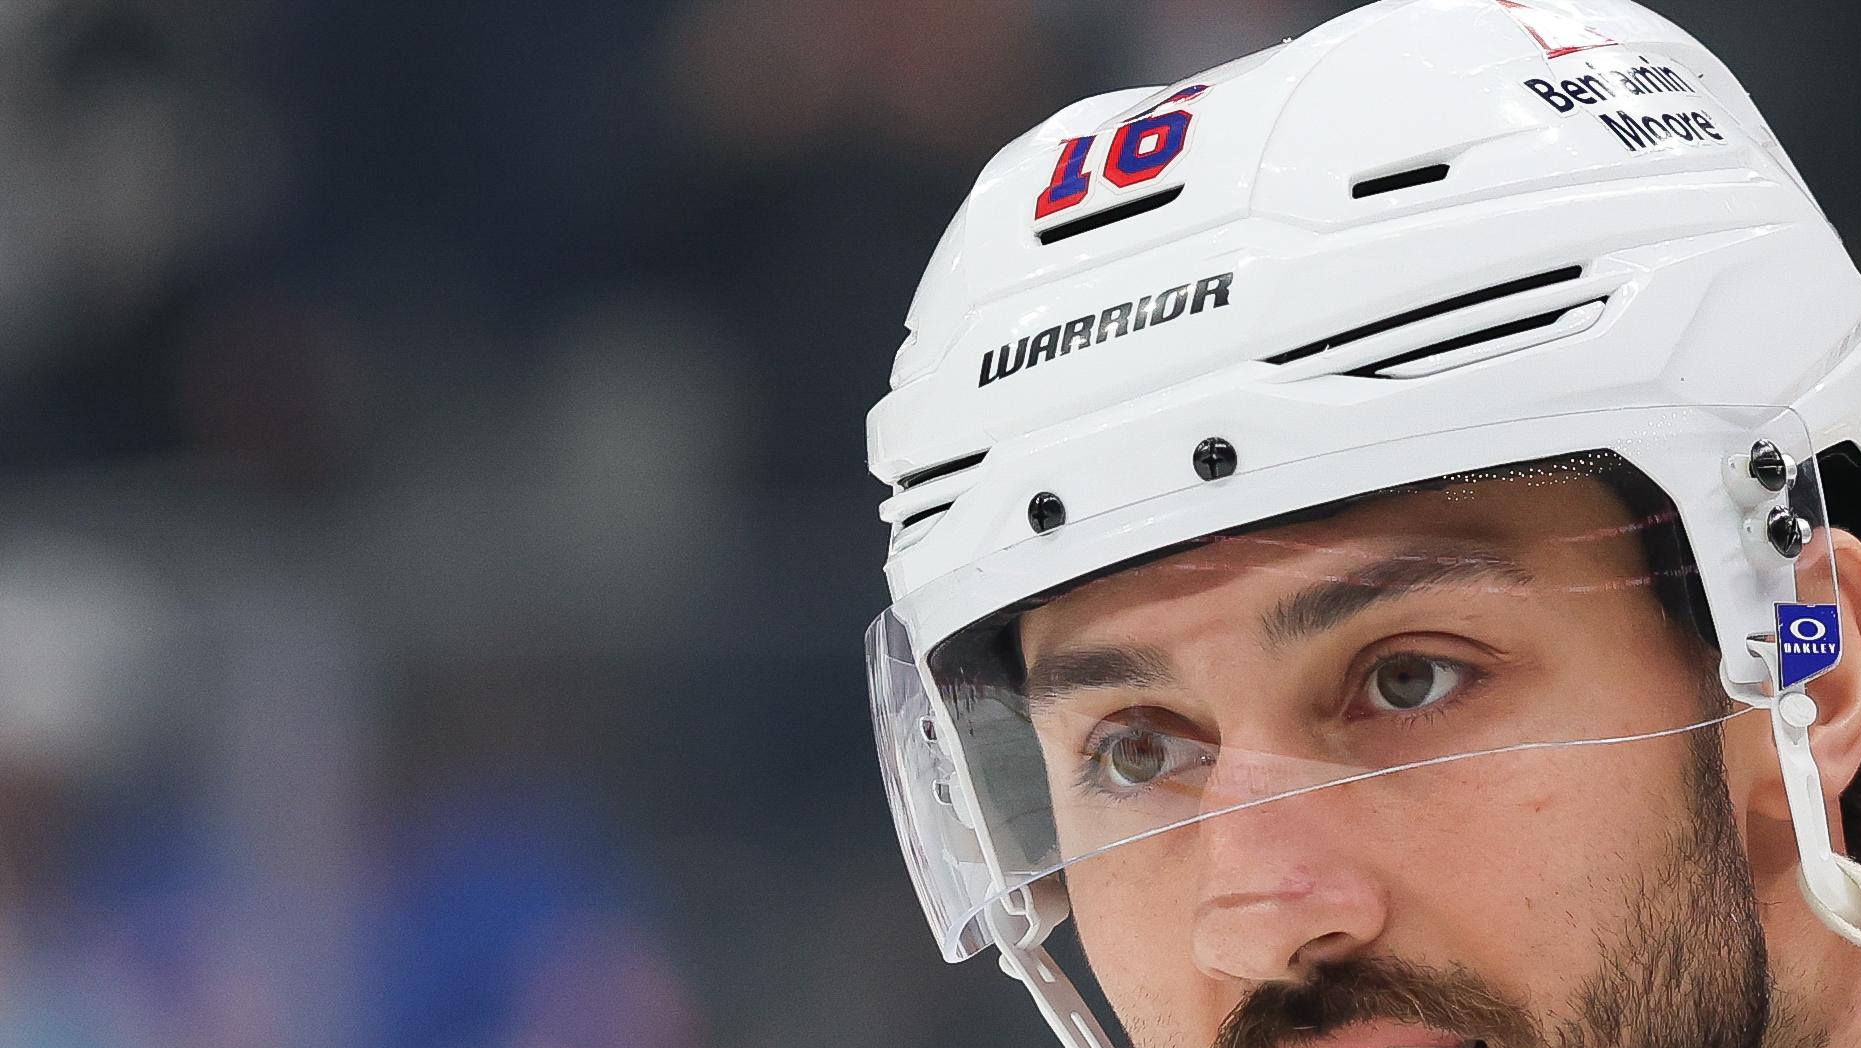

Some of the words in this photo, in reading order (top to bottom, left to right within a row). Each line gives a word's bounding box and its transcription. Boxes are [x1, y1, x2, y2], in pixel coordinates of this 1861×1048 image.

[1524, 56, 1696, 113] Benamin
[1598, 110, 1724, 152] Moore
[978, 272, 1233, 388] WARRIOR
[1783, 642, 1836, 655] OAKLEY
